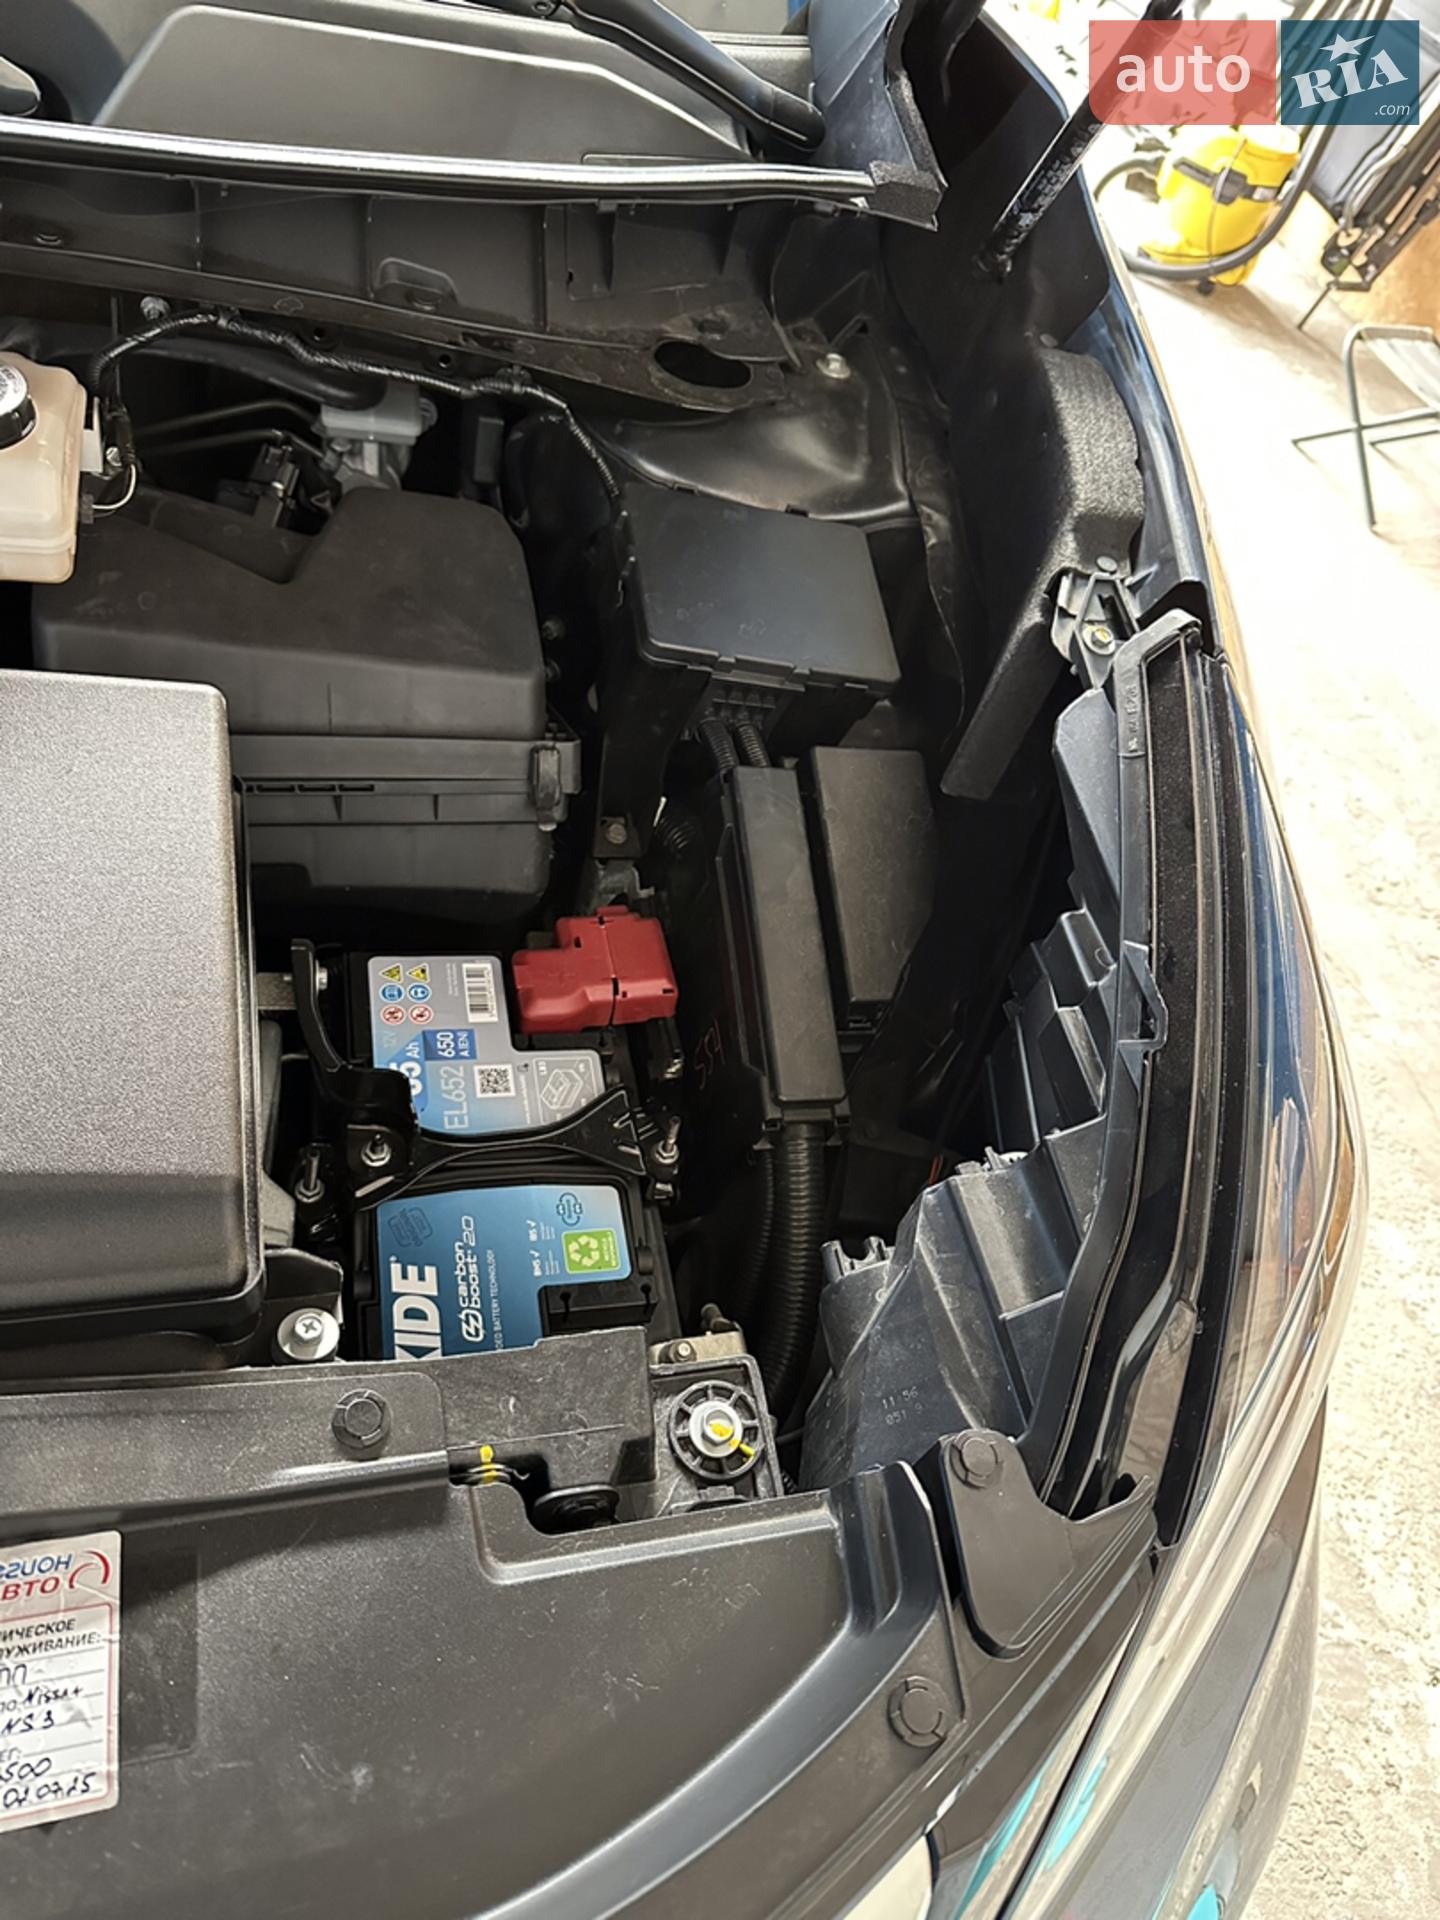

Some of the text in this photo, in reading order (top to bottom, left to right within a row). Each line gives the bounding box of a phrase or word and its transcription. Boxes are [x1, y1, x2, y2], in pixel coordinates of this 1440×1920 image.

[405, 1042, 421, 1059] Ah
[436, 1031, 456, 1058] 650
[440, 1065, 469, 1130] EL652
[454, 1241, 470, 1308] carbon
[468, 1254, 482, 1310] boost
[486, 1249, 499, 1297] TECHNOLOGY
[491, 1299, 502, 1331] BATTERY
